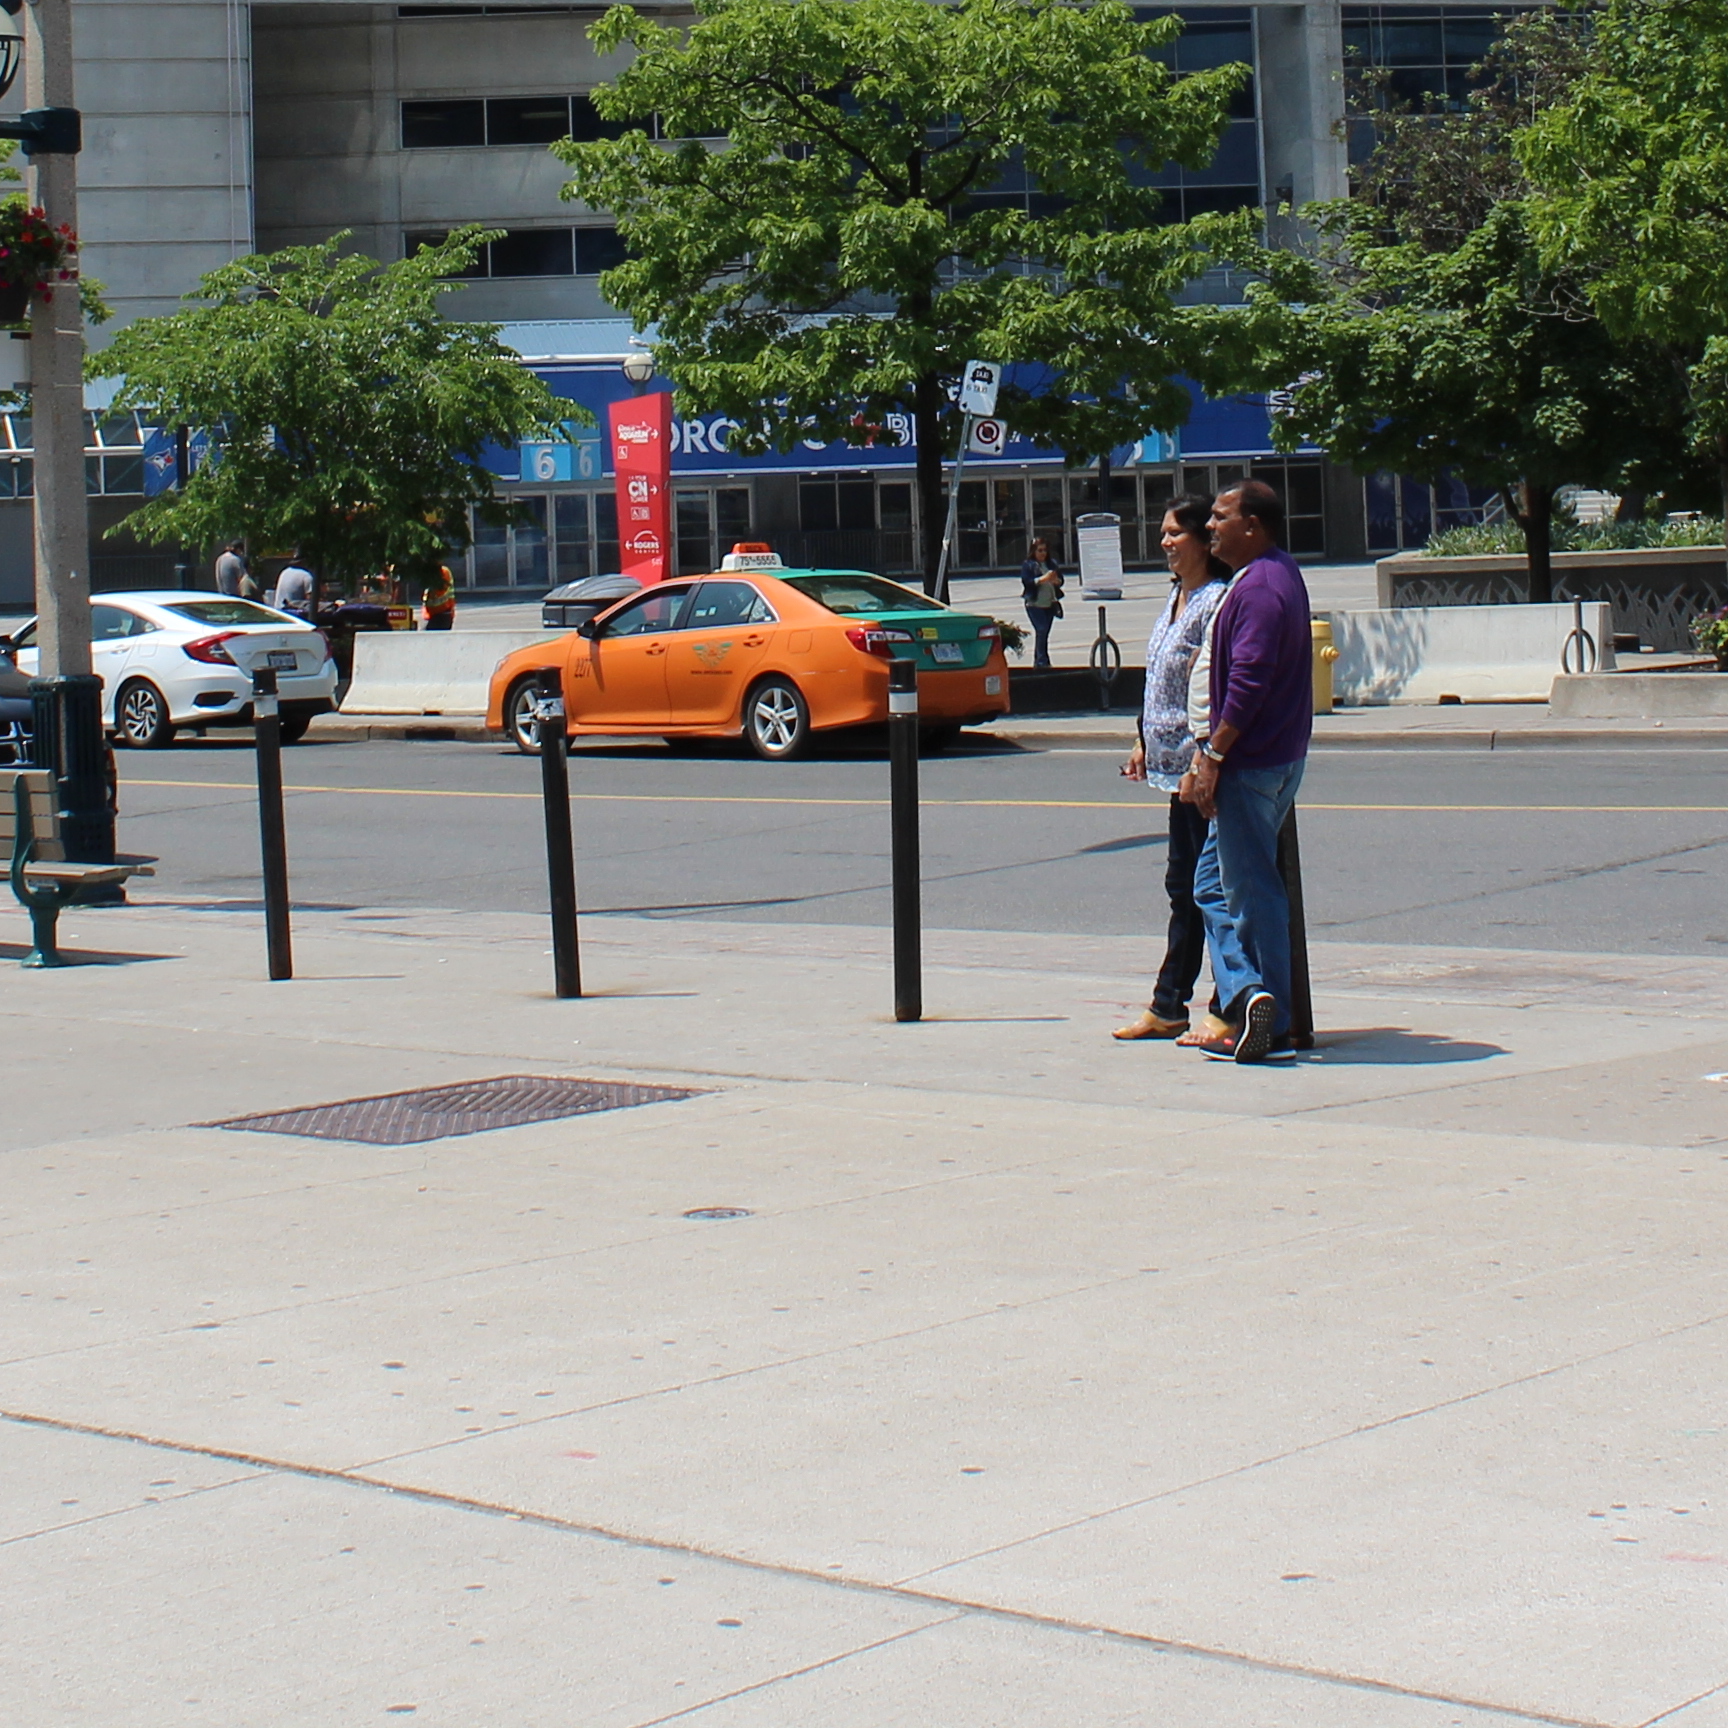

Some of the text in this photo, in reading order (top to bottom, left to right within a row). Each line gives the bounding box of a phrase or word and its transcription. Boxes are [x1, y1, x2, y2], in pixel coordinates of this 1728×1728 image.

[535, 446, 555, 480] 6
[580, 445, 592, 478] 6
[628, 481, 648, 496] CN
[633, 541, 660, 549] ROGERS
